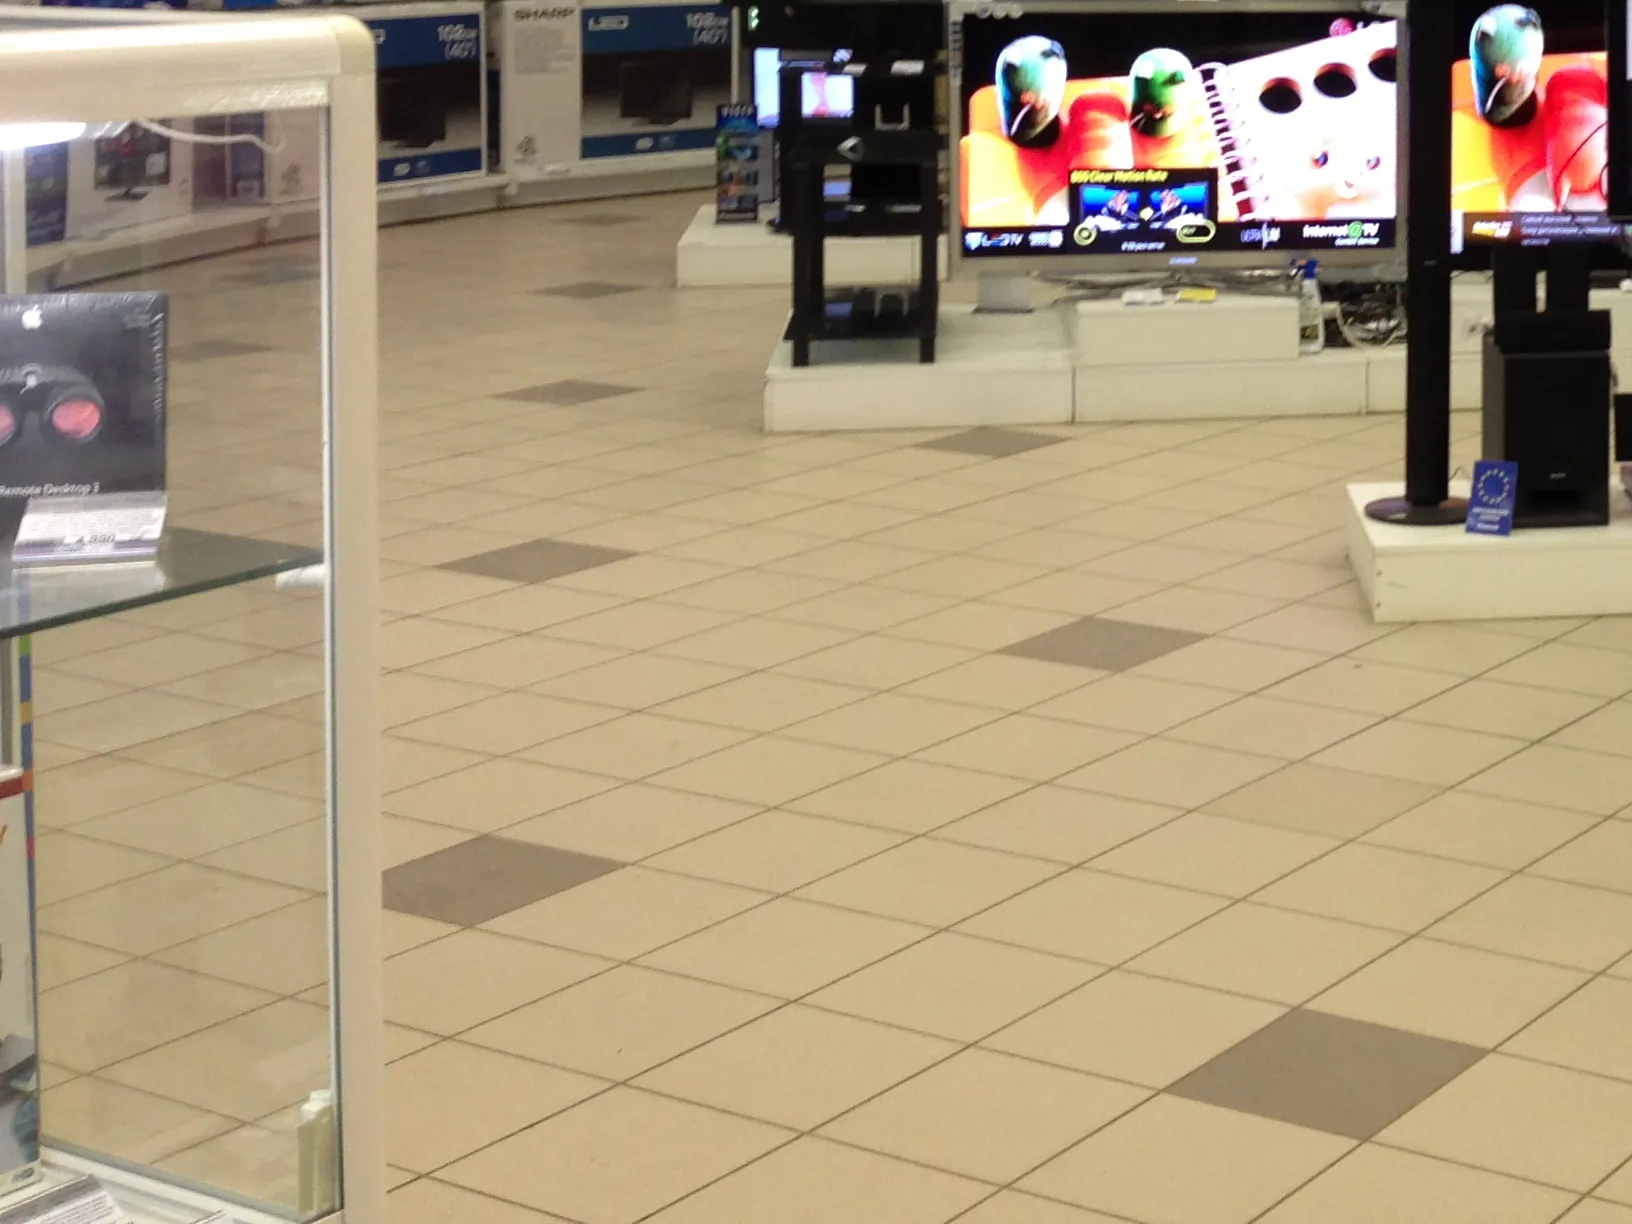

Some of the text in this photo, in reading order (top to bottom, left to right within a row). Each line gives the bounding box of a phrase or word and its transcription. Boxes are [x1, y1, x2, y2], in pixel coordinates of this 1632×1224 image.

[513, 7, 575, 22] SHARP
[588, 15, 629, 30] LED
[43, 483, 92, 495] Desktop
